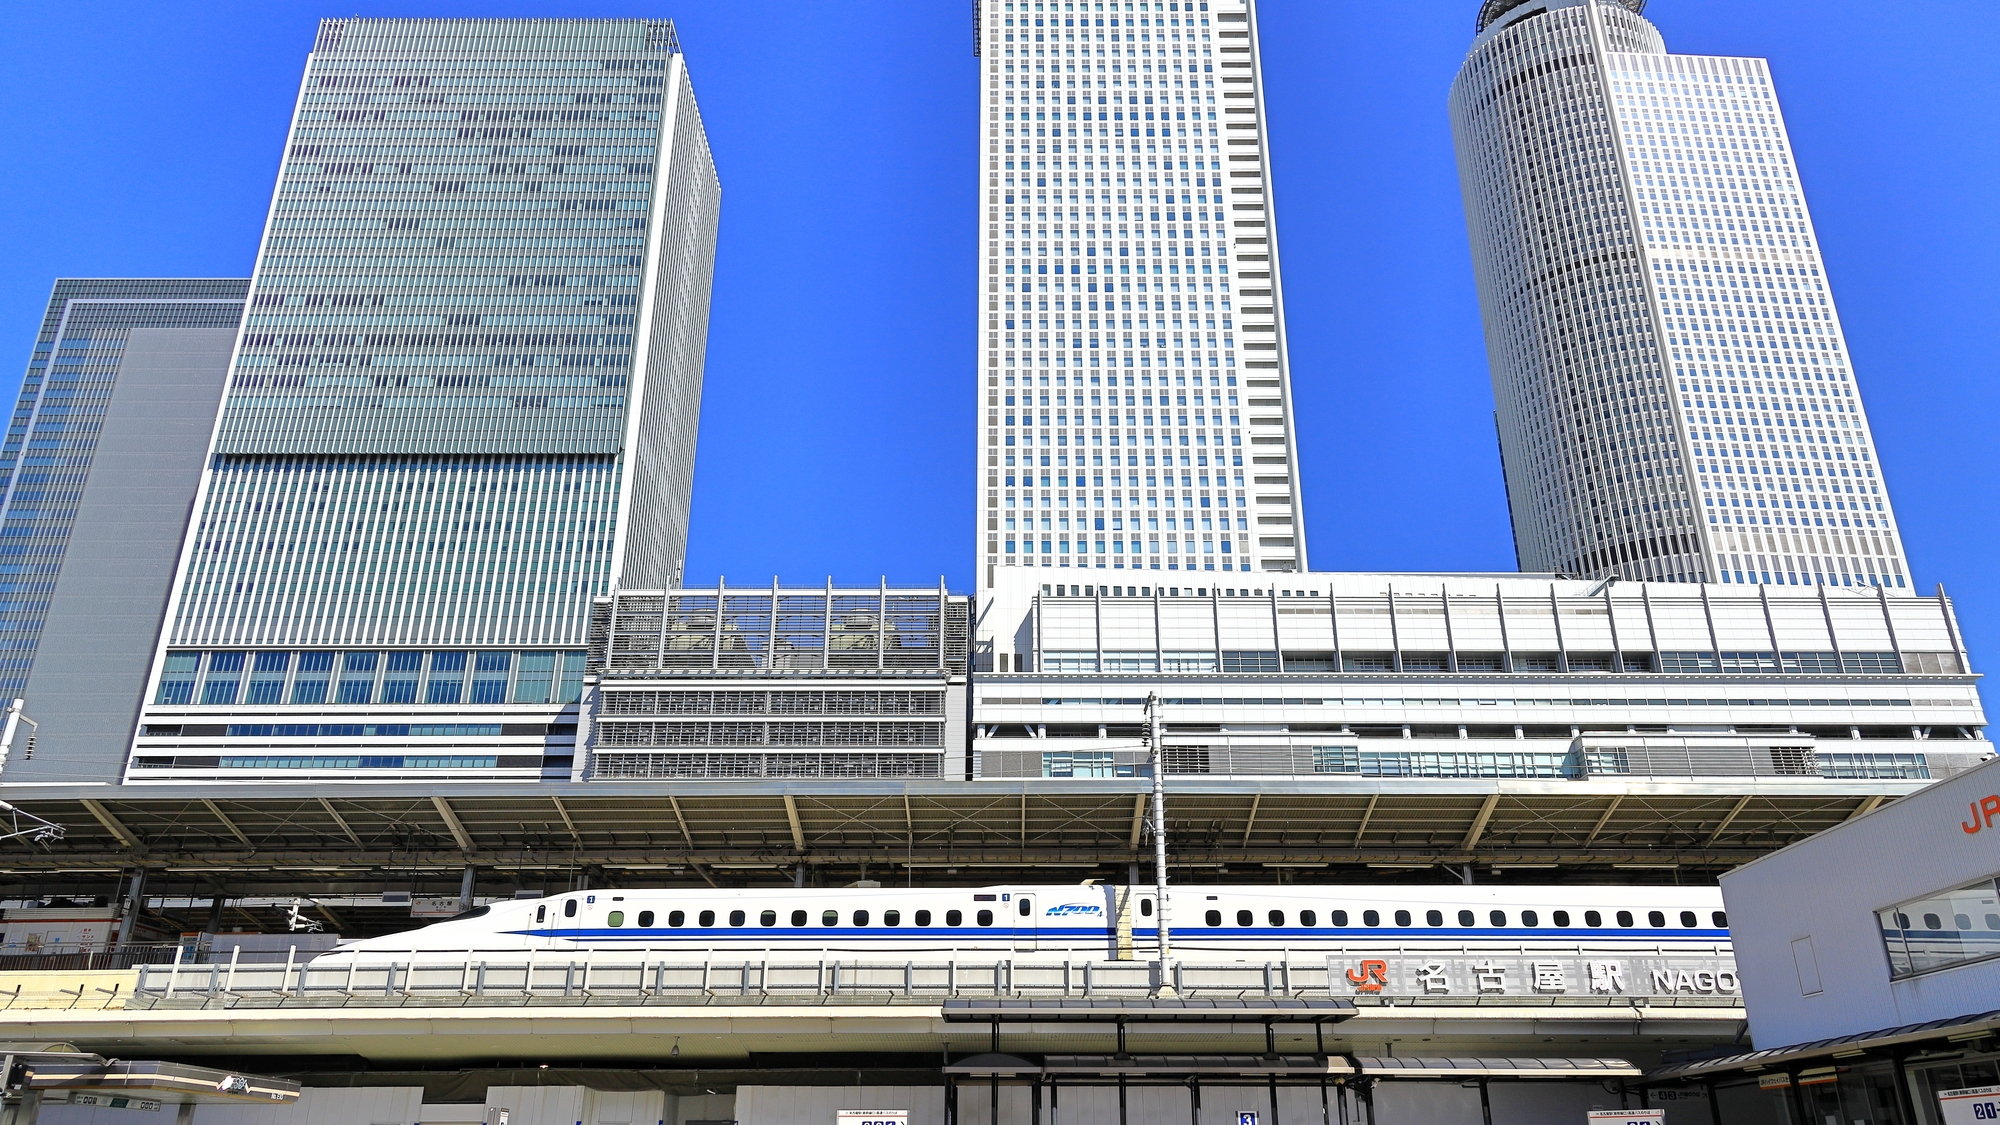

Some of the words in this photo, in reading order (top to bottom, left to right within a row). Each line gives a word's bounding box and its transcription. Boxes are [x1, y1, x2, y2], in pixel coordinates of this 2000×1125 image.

[1347, 960, 1388, 983] JR
[1416, 960, 1625, 992] 名古屋駅
[1651, 969, 1740, 992] NAGO
